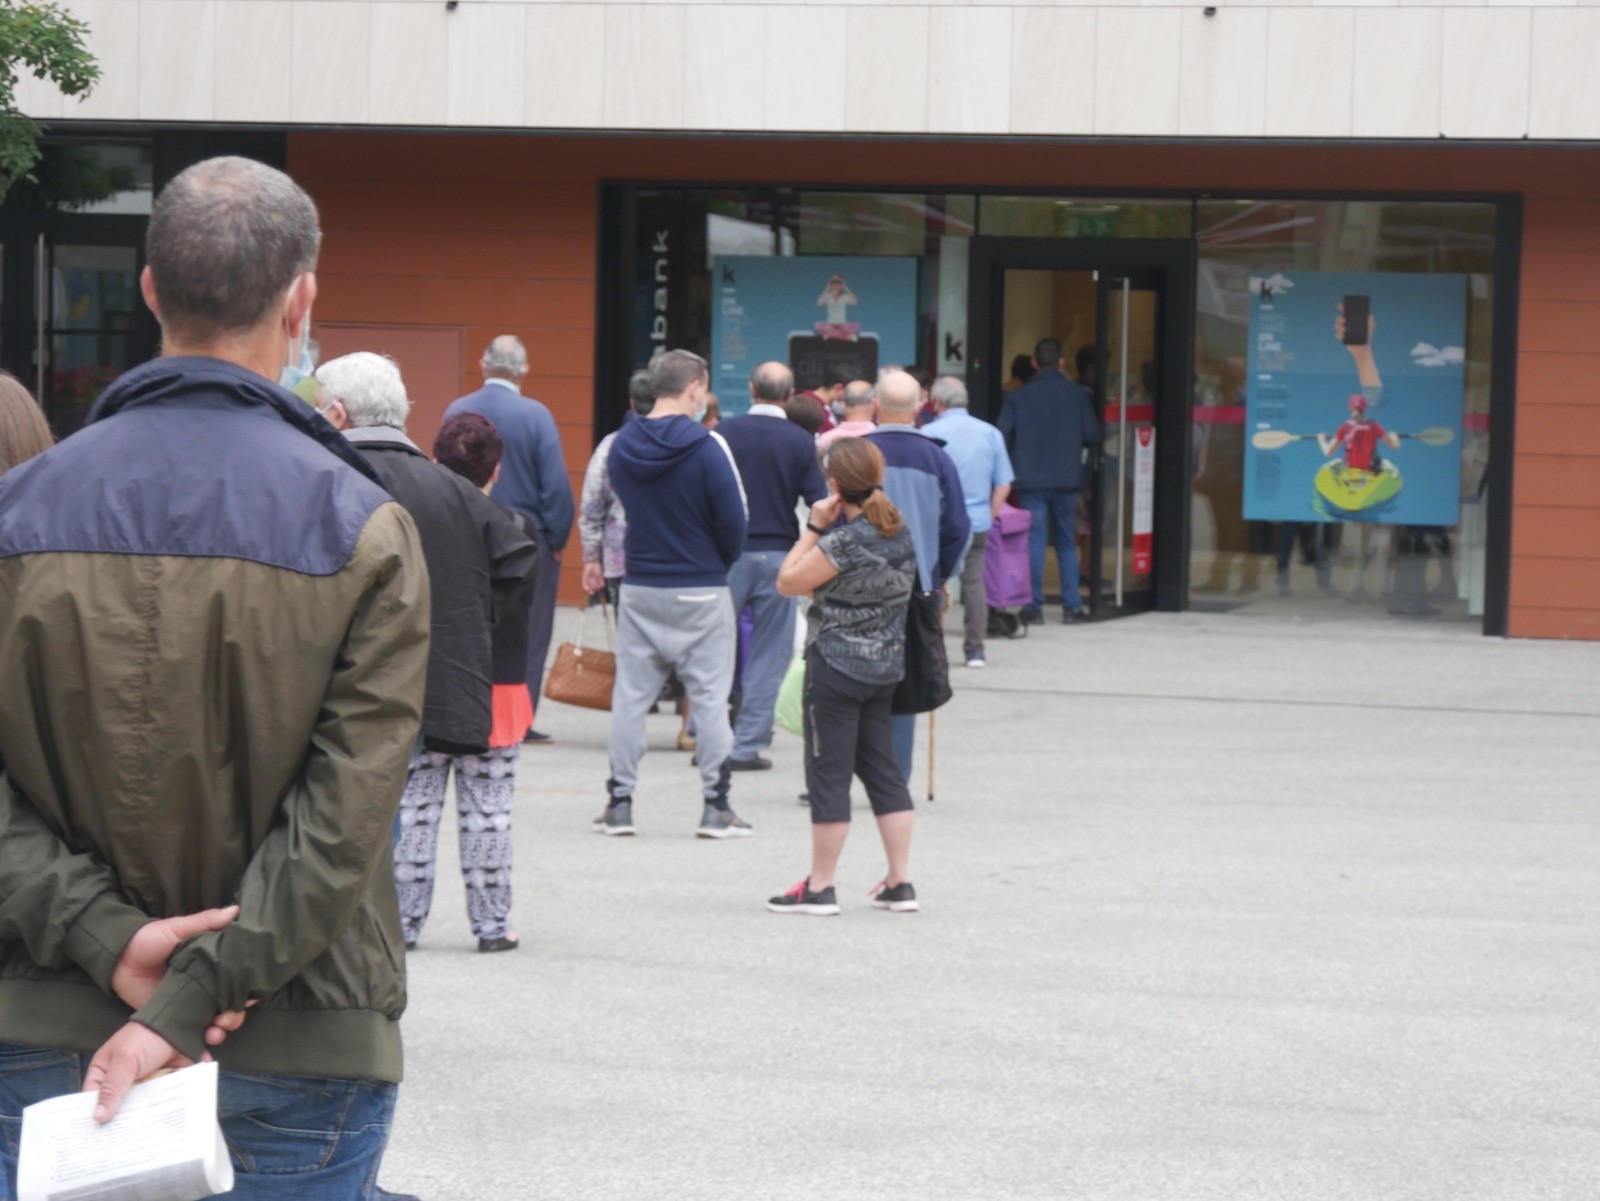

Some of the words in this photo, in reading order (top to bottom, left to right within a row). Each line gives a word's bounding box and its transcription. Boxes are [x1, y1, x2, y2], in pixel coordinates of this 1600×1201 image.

[722, 265, 736, 284] k
[1260, 280, 1273, 301] k
[944, 332, 962, 362] k
